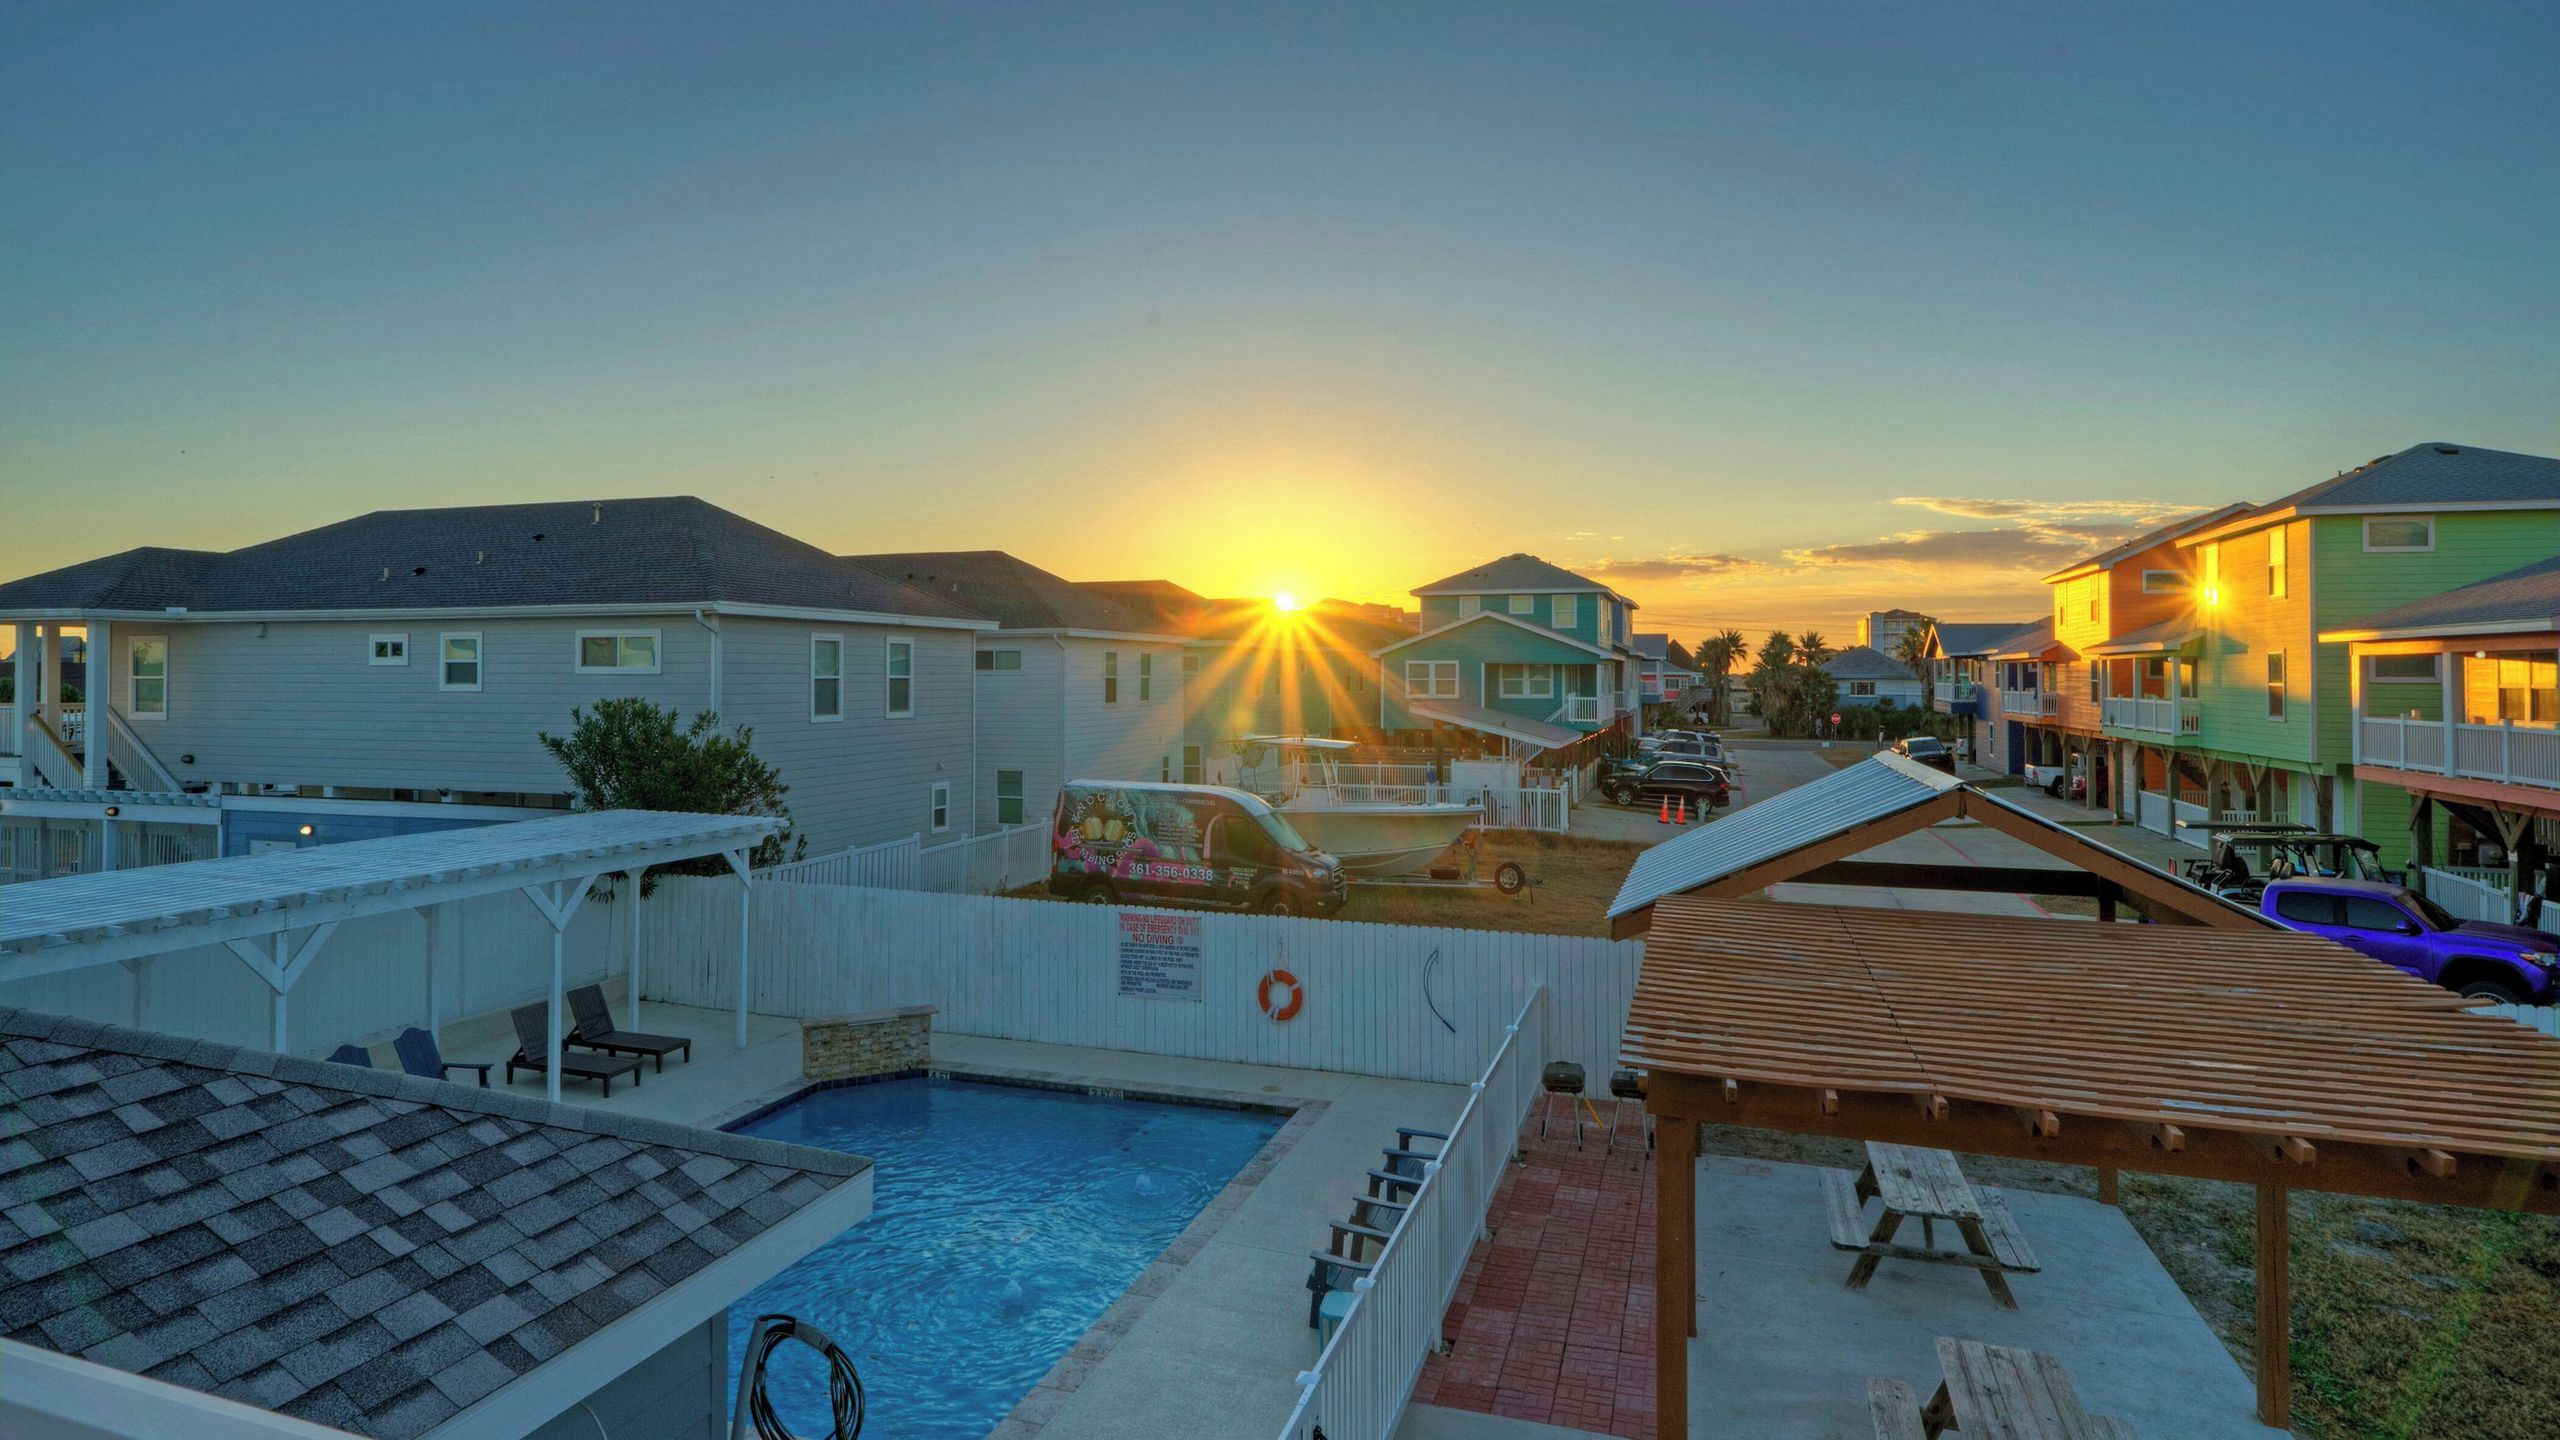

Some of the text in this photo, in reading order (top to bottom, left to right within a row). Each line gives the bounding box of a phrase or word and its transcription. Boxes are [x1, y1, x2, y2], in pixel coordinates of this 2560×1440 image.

[1071, 792, 1137, 827] KNOCKOUT
[1128, 862, 1214, 881] 361-356-0338
[1126, 922, 1140, 932] CASE
[1140, 923, 1147, 933] OF
[1146, 924, 1177, 935] EMERGENCY
[1132, 933, 1174, 945] NO DIVING
